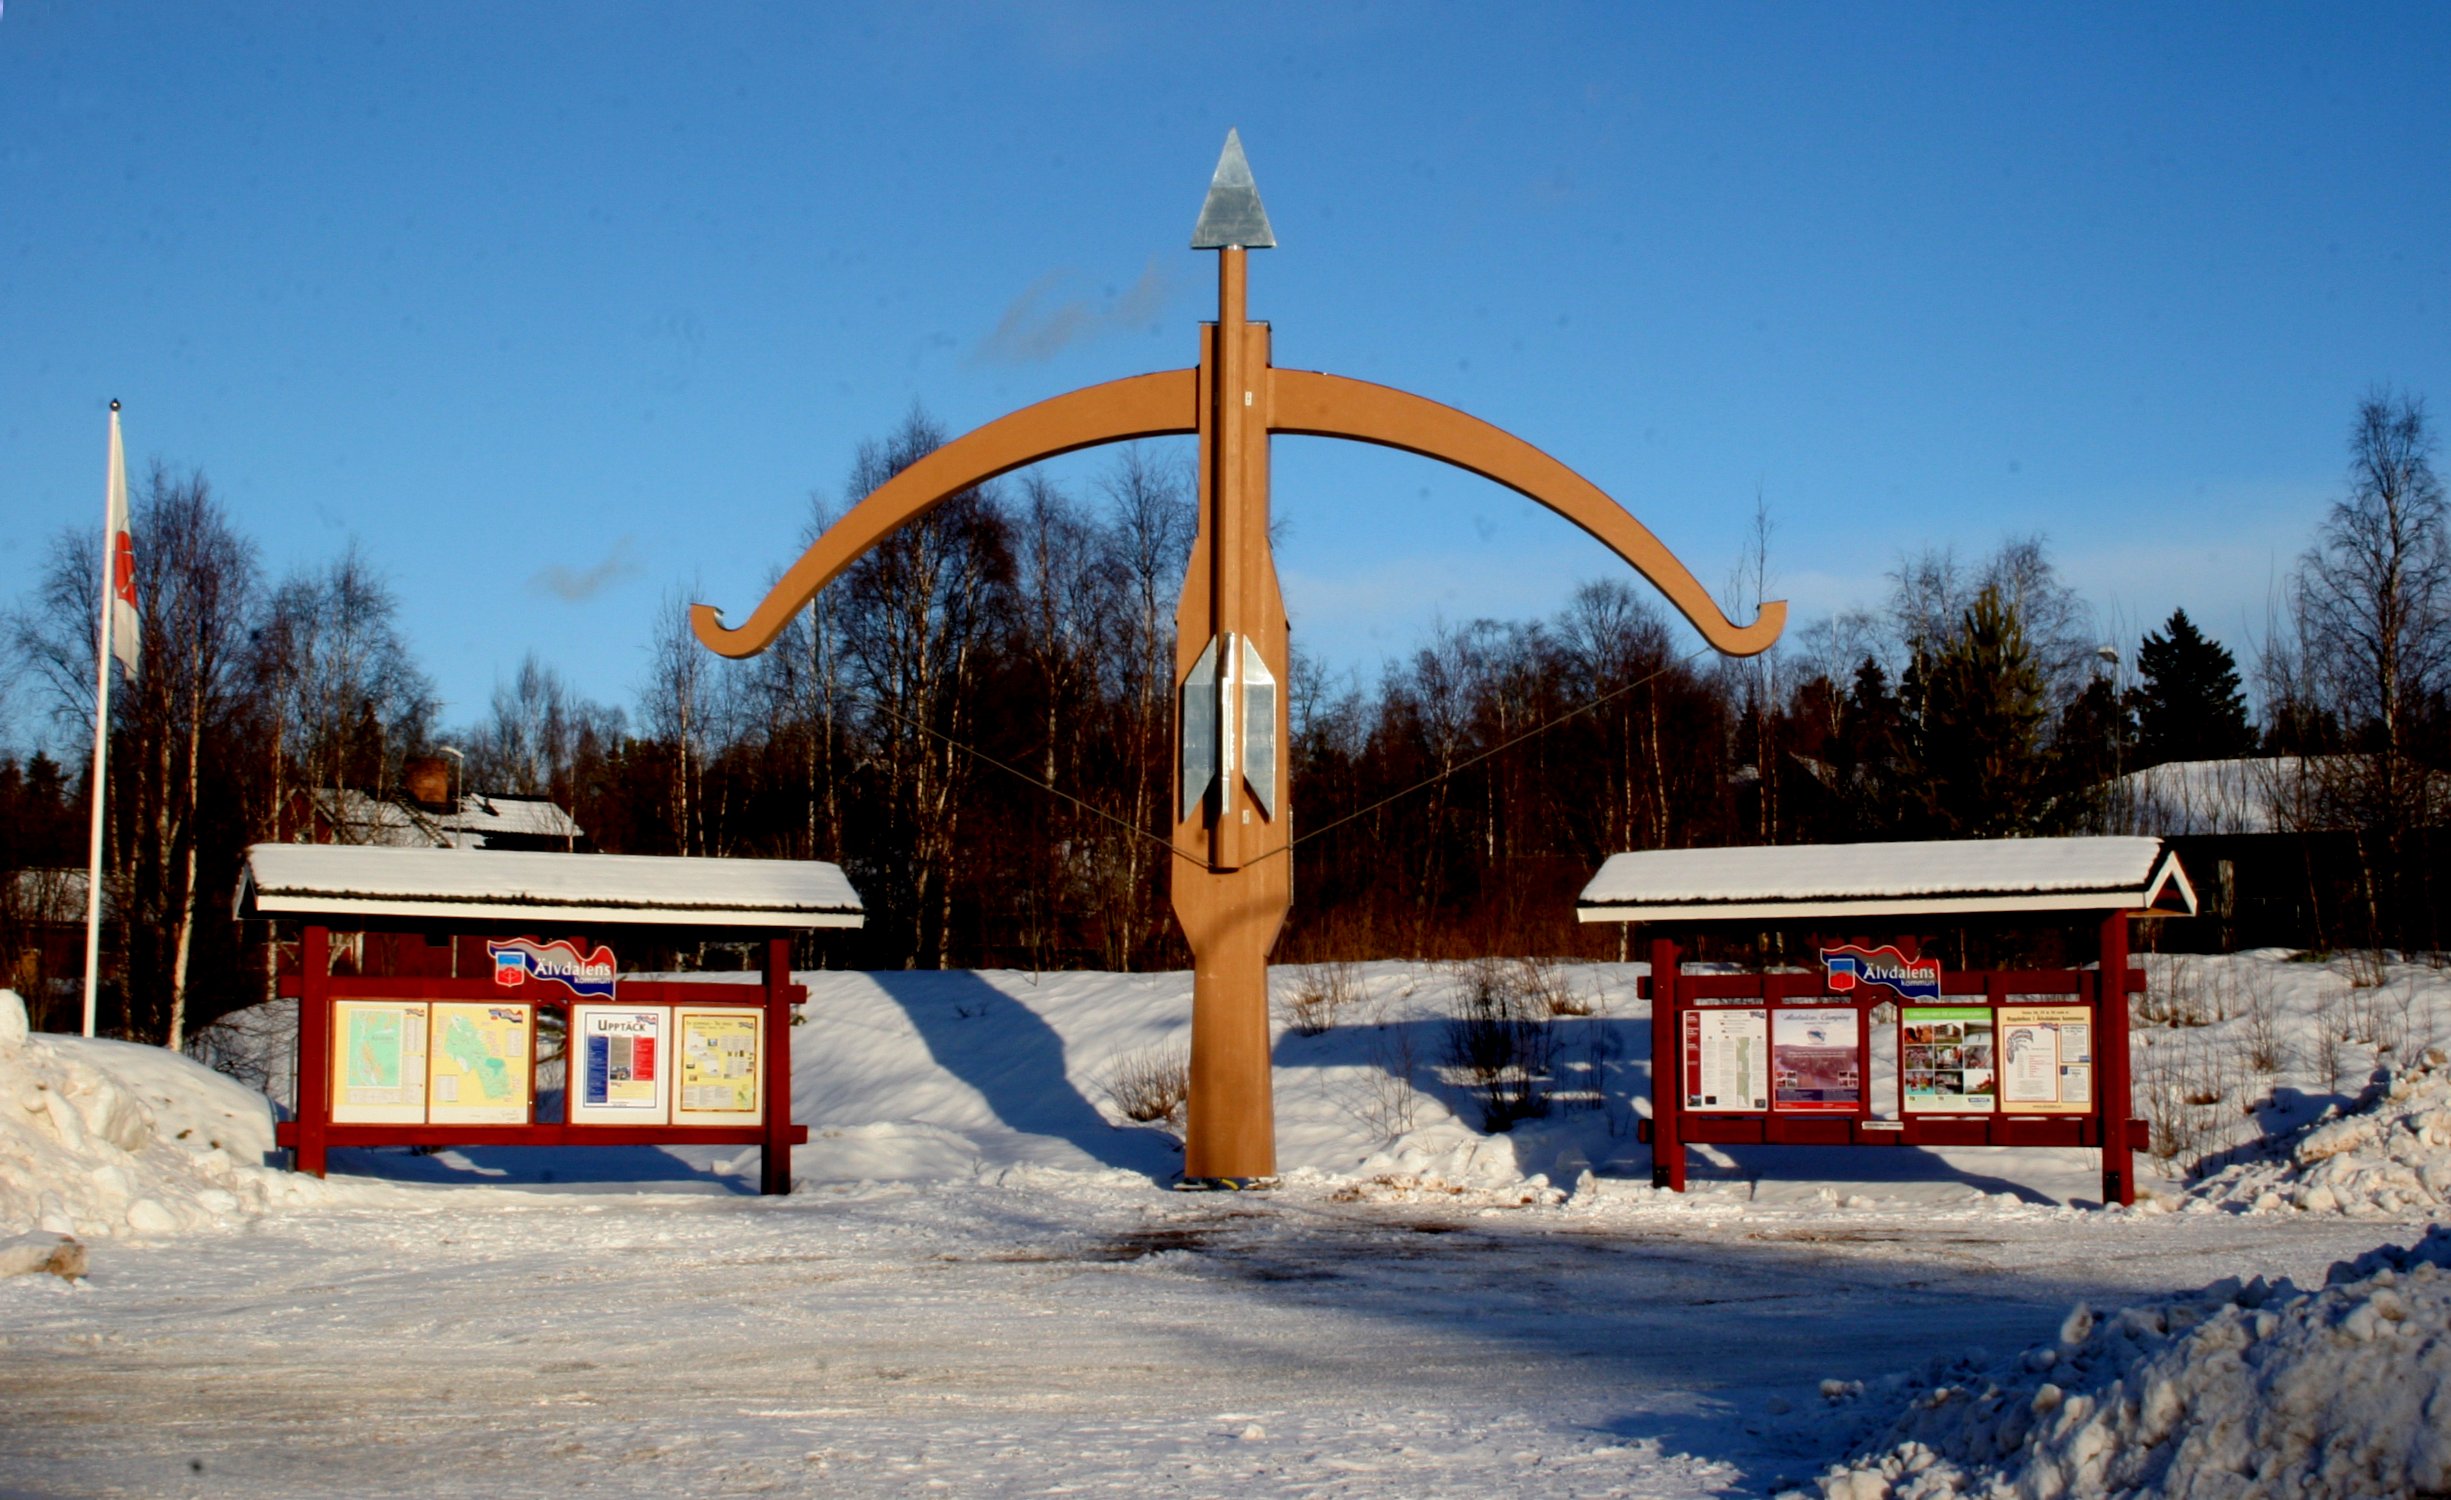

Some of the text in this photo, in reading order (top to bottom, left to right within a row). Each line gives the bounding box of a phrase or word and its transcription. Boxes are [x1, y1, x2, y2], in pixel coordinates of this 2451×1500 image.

[534, 958, 611, 976] Älvdalens
[1863, 963, 1935, 979] Älvdalens
[574, 975, 611, 984] kommun
[1900, 978, 1936, 986] kommun
